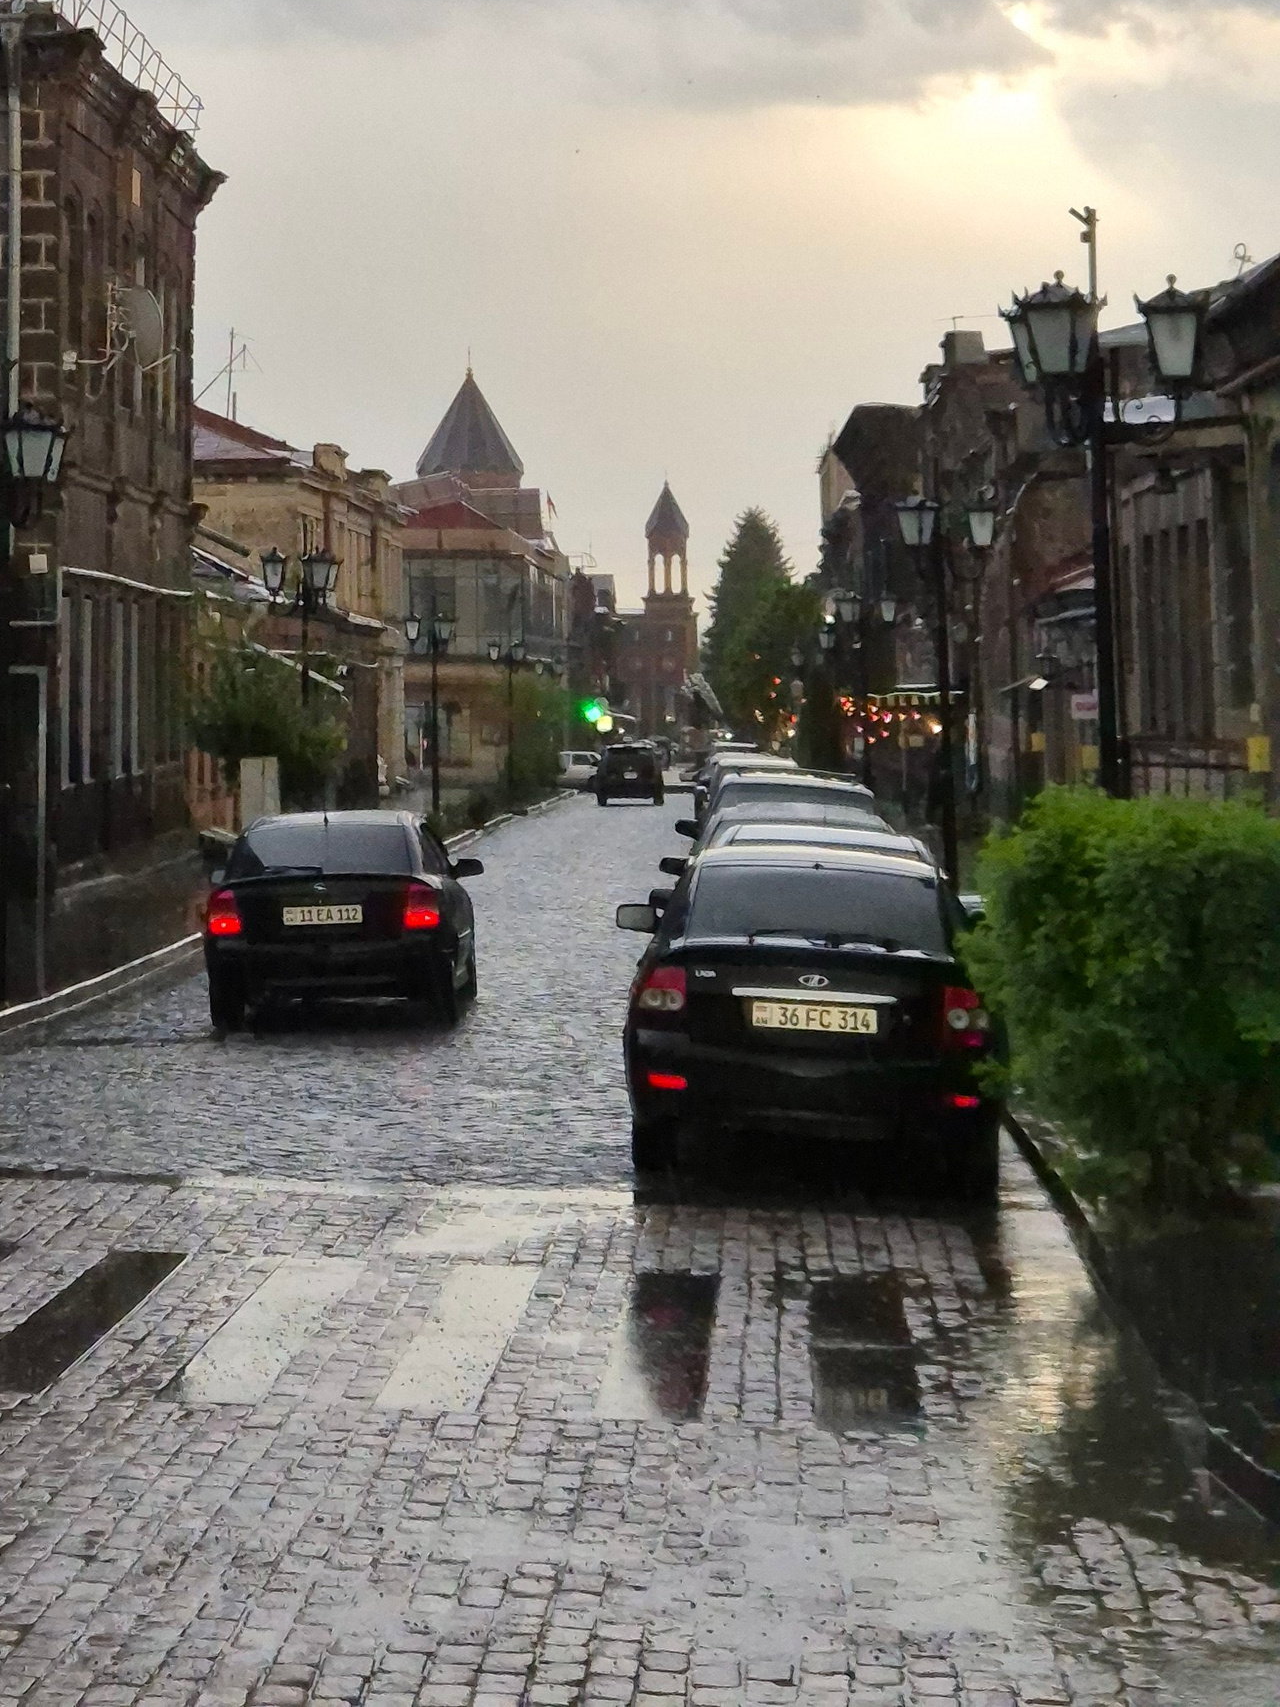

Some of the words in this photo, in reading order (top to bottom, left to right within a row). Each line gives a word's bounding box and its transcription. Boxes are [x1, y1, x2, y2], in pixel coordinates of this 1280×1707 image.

[300, 909, 313, 922] 11
[317, 909, 333, 922] EA
[337, 907, 358, 921] 112
[778, 1006, 799, 1026] 36
[805, 1008, 831, 1029] FC
[838, 1010, 870, 1031] 314
